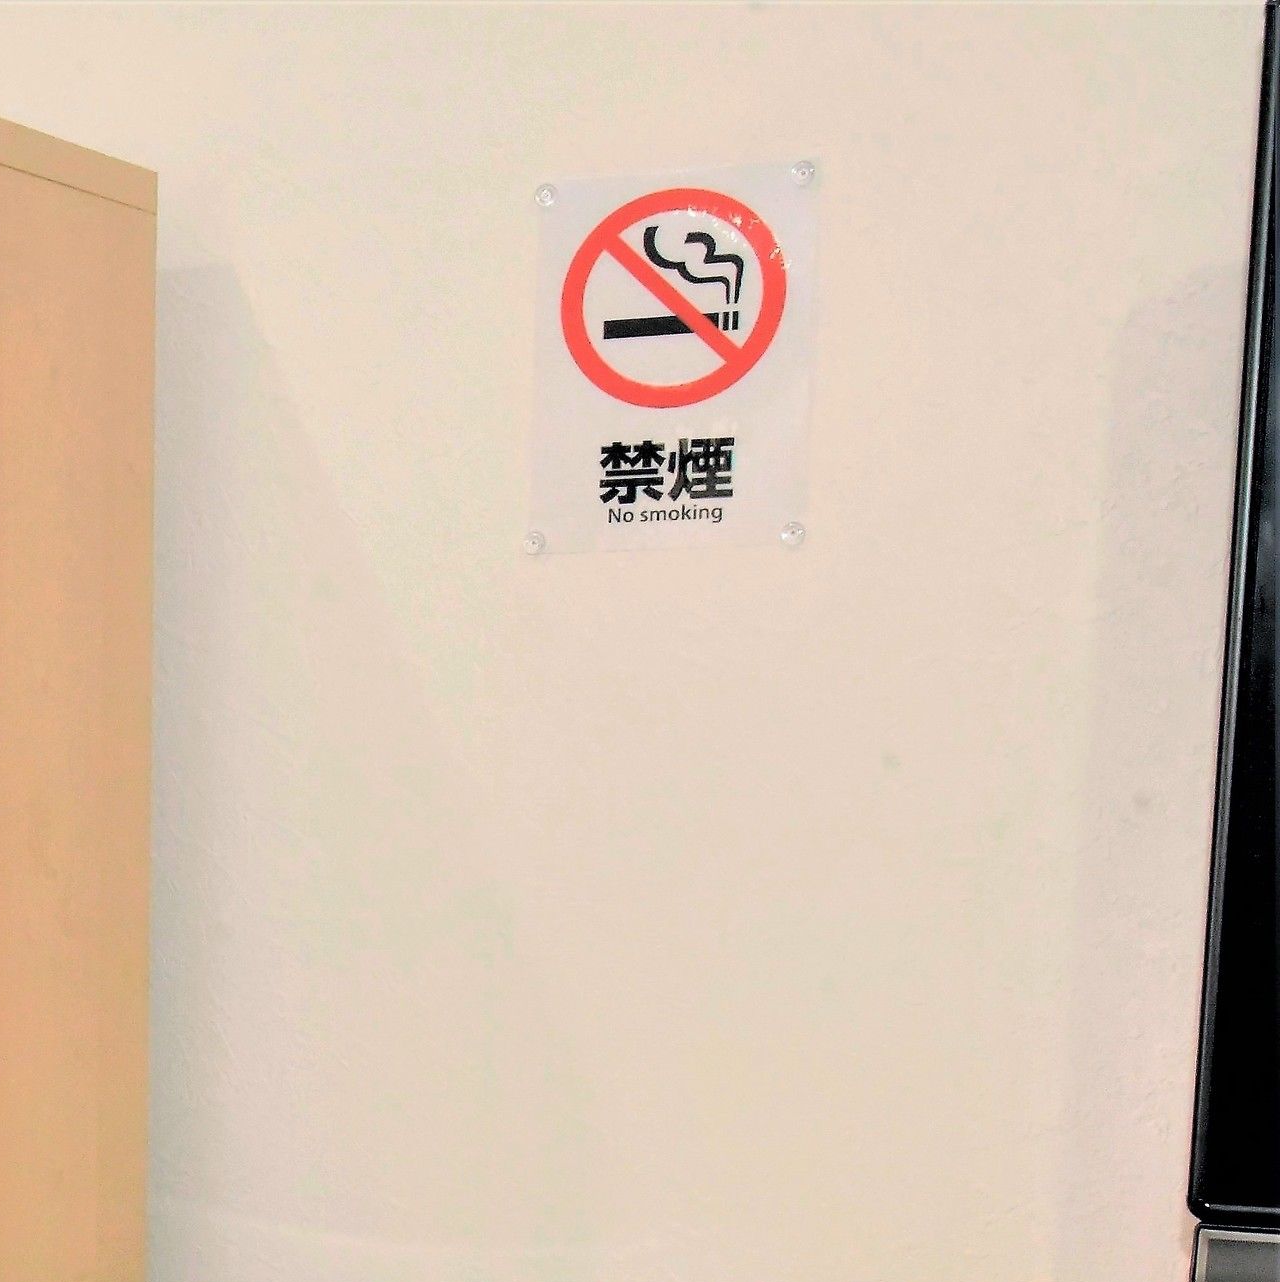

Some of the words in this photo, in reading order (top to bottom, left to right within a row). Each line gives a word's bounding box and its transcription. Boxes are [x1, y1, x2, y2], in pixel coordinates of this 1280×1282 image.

[599, 437, 735, 505] 禁煙
[608, 507, 634, 524] No
[640, 504, 723, 524] smoking
